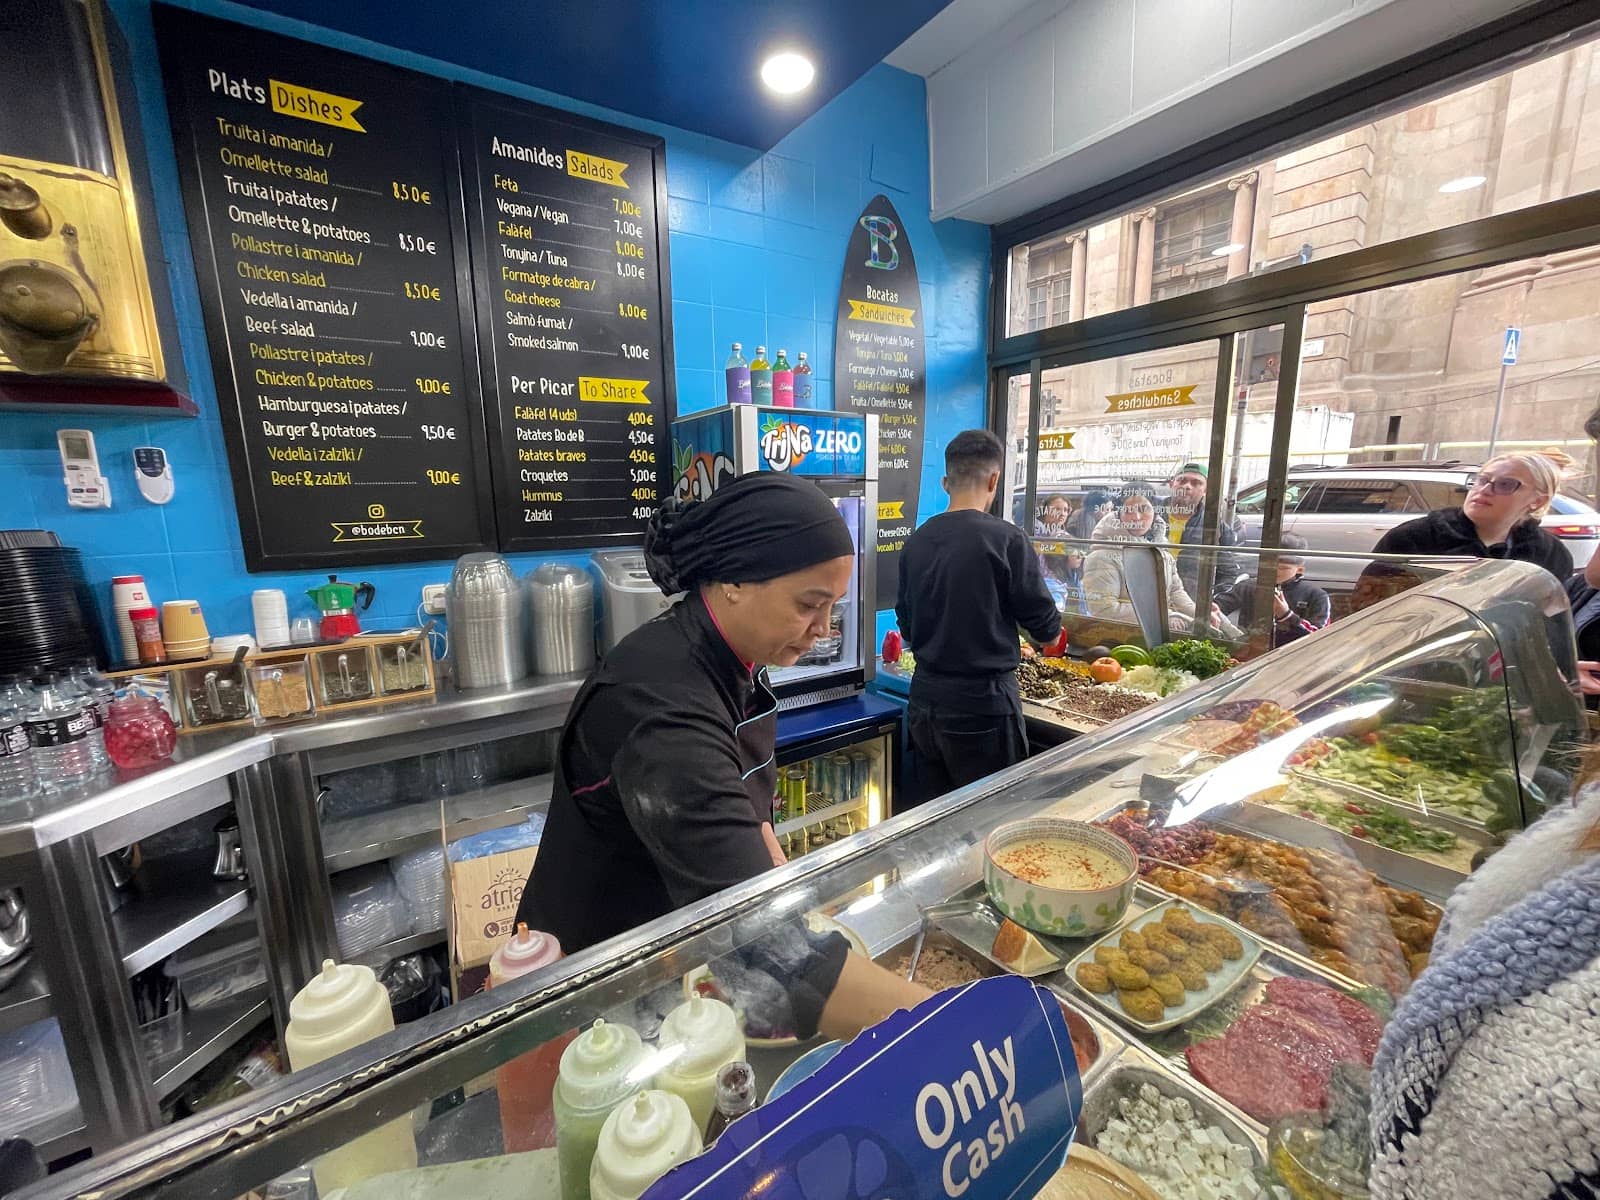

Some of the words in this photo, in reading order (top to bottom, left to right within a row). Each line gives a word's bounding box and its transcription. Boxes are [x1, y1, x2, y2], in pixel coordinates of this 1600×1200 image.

[208, 68, 266, 104] Plats
[277, 87, 342, 122] Dishes
[216, 117, 262, 144] Truita
[269, 132, 324, 156] amanida
[220, 148, 292, 177] Omellette
[295, 164, 328, 185] salad
[492, 136, 564, 170] Amanides
[570, 156, 614, 181] Salads
[224, 175, 268, 199] Truita
[276, 188, 328, 212] patates
[494, 174, 518, 193] Feta
[496, 198, 532, 218] Vegana
[540, 206, 568, 226] Vegan
[228, 205, 300, 234] Omellette
[301, 218, 312, 234] &
[313, 222, 370, 244] potatoes
[232, 232, 292, 258] Pollastre
[302, 246, 355, 266] amanida
[501, 244, 538, 264] Tonyina
[546, 252, 568, 267] Tuna
[238, 260, 289, 284] Chicken
[292, 269, 326, 288] salad
[502, 266, 551, 288] Formatge
[552, 276, 564, 288] de
[565, 278, 590, 290] cabra
[240, 288, 289, 310] Vedella
[297, 298, 349, 316] amanida
[504, 289, 528, 304] Goat
[528, 292, 560, 308] cheese
[866, 284, 898, 304] Bocatas
[536, 314, 567, 330] fumat
[860, 304, 905, 324] Sandwiches
[245, 316, 278, 334] Beef
[280, 320, 315, 338] salad
[508, 332, 546, 350] Smoked
[546, 336, 578, 352] salmon
[250, 342, 308, 362] Pollastre
[316, 350, 366, 366] patates
[255, 370, 306, 388] Chicken
[307, 372, 316, 387] &
[318, 375, 374, 392] potatoes
[512, 376, 536, 394] Per
[540, 379, 575, 396] Picar
[582, 380, 598, 396] To
[602, 383, 636, 398] Share
[258, 396, 348, 416] Hamburguesa
[354, 401, 400, 418] patates
[262, 422, 308, 440] Burger
[311, 422, 320, 436] &
[322, 424, 376, 440] potatoes
[516, 428, 552, 442] Patates
[816, 430, 862, 454] ZERO
[268, 446, 312, 461] Vedella
[518, 448, 554, 462] Patates
[556, 450, 586, 462] braves
[272, 471, 302, 486] Beef
[304, 471, 314, 485] &
[520, 469, 568, 484] Croquetes
[522, 489, 563, 502] Hummus
[524, 509, 552, 522] Zalziki
[352, 524, 406, 536] @bodebcn
[916, 1035, 1016, 1150] Only
[942, 1096, 1026, 1198] Cash
